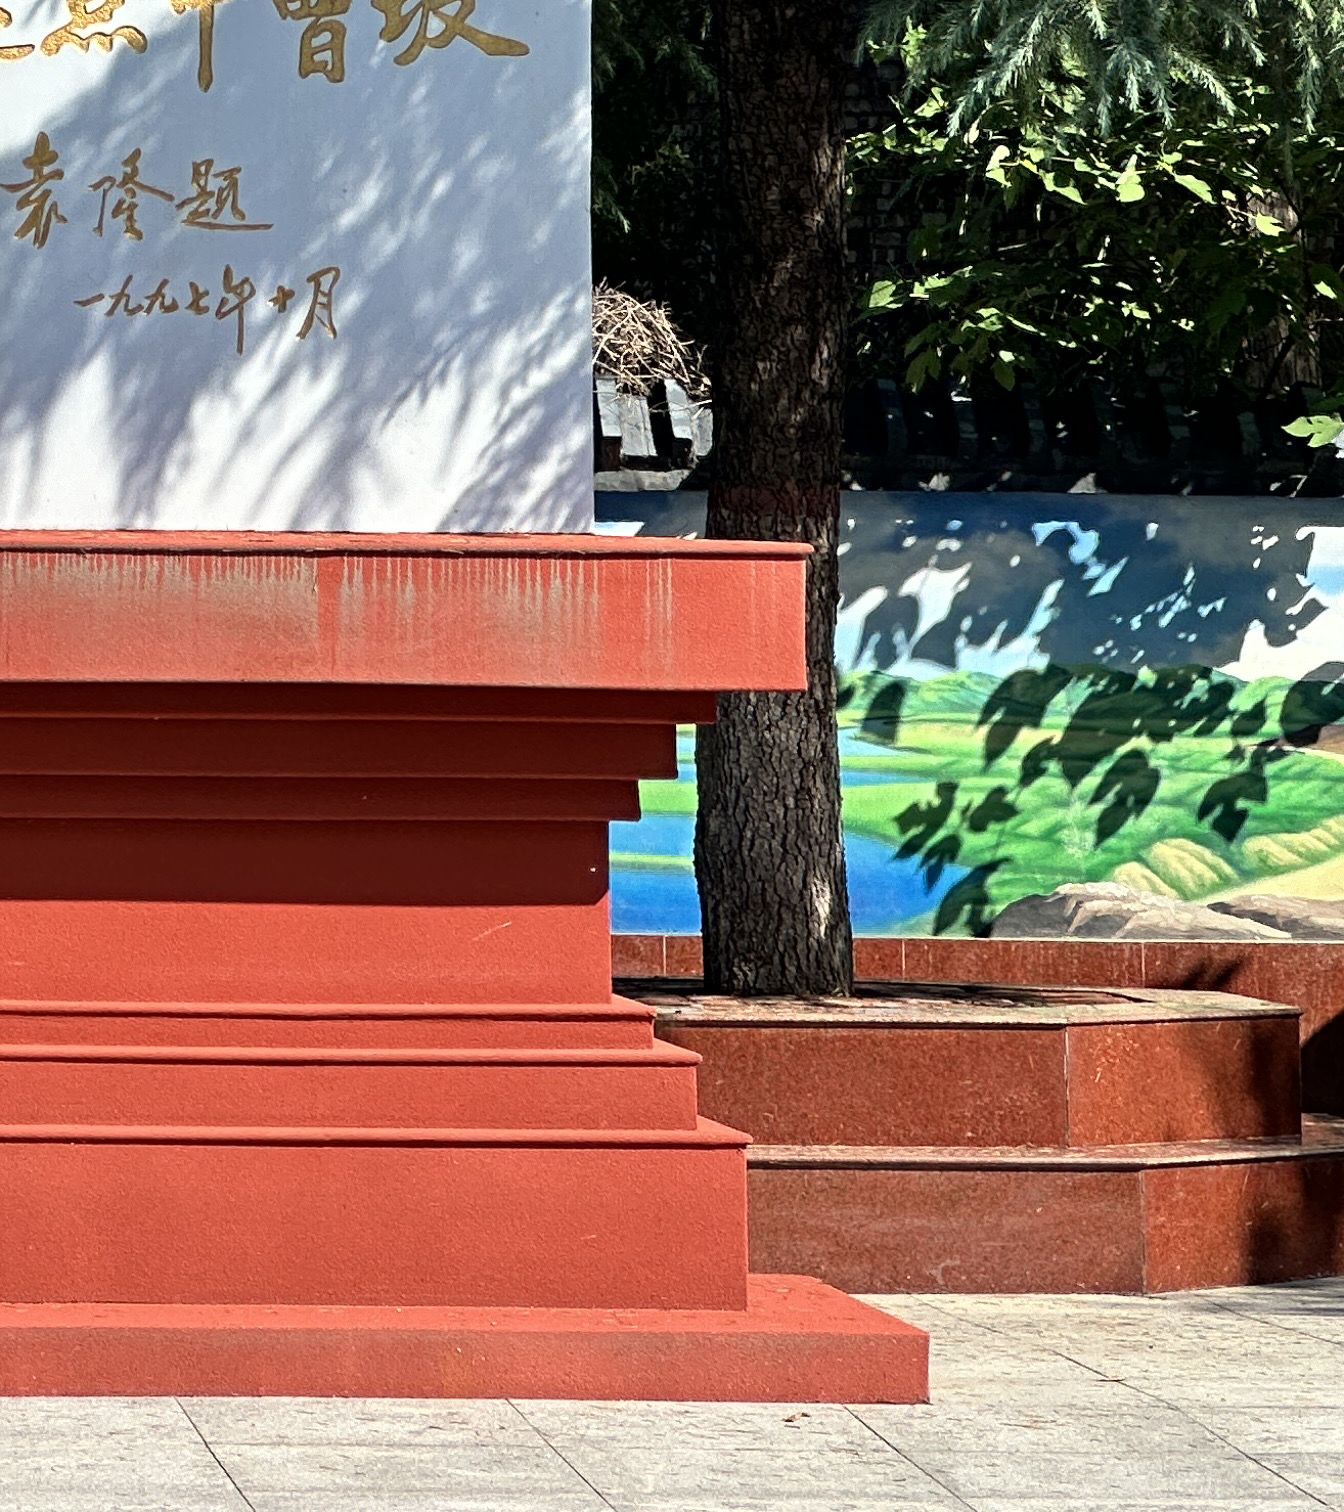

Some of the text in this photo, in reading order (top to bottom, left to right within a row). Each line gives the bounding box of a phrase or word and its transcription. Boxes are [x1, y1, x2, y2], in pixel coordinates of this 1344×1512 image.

[73, 264, 341, 356] 一九九七年十月
